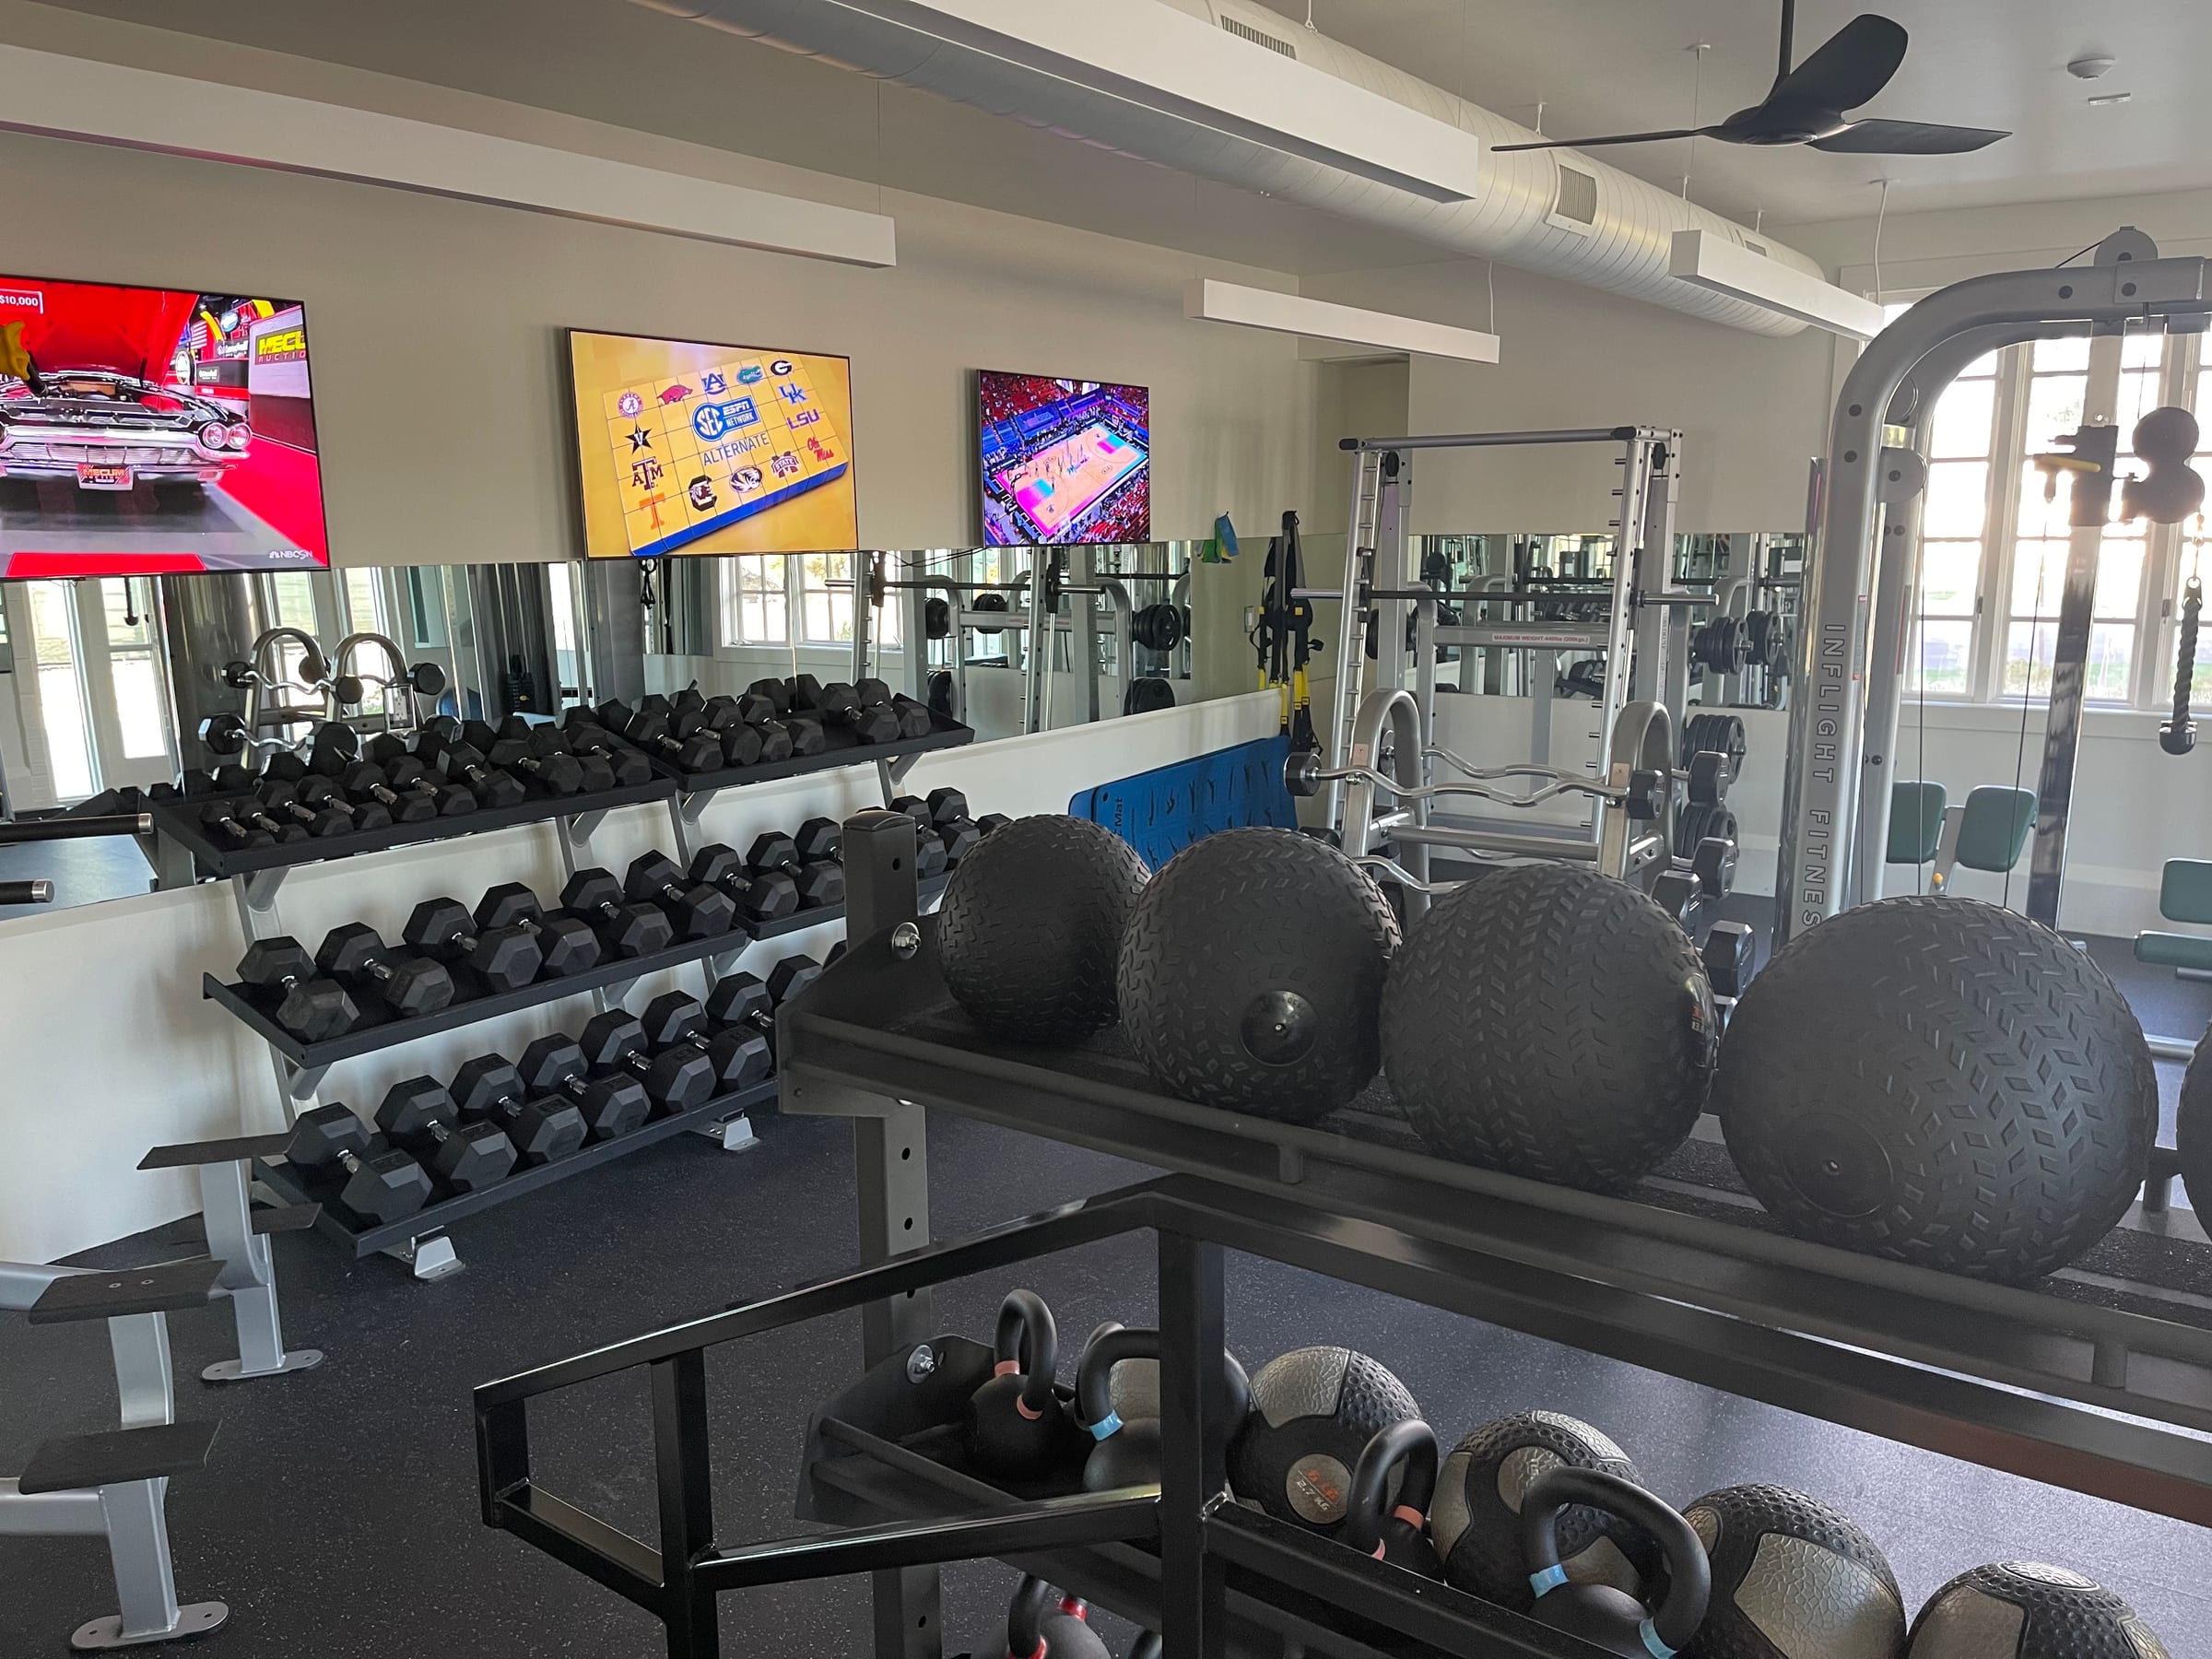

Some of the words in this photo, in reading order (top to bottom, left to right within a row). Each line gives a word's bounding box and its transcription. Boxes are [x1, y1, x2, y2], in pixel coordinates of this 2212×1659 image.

[0, 294, 39, 306] $10,000
[723, 401, 750, 416] ESPN
[697, 407, 724, 436] SEC
[725, 412, 755, 428] NETWORK
[786, 408, 820, 429] LSU
[703, 432, 770, 466] ALTERNATE
[775, 457, 797, 473] STATE
[279, 548, 313, 560] NBCSN
[1812, 624, 1846, 782] INFLIGHT
